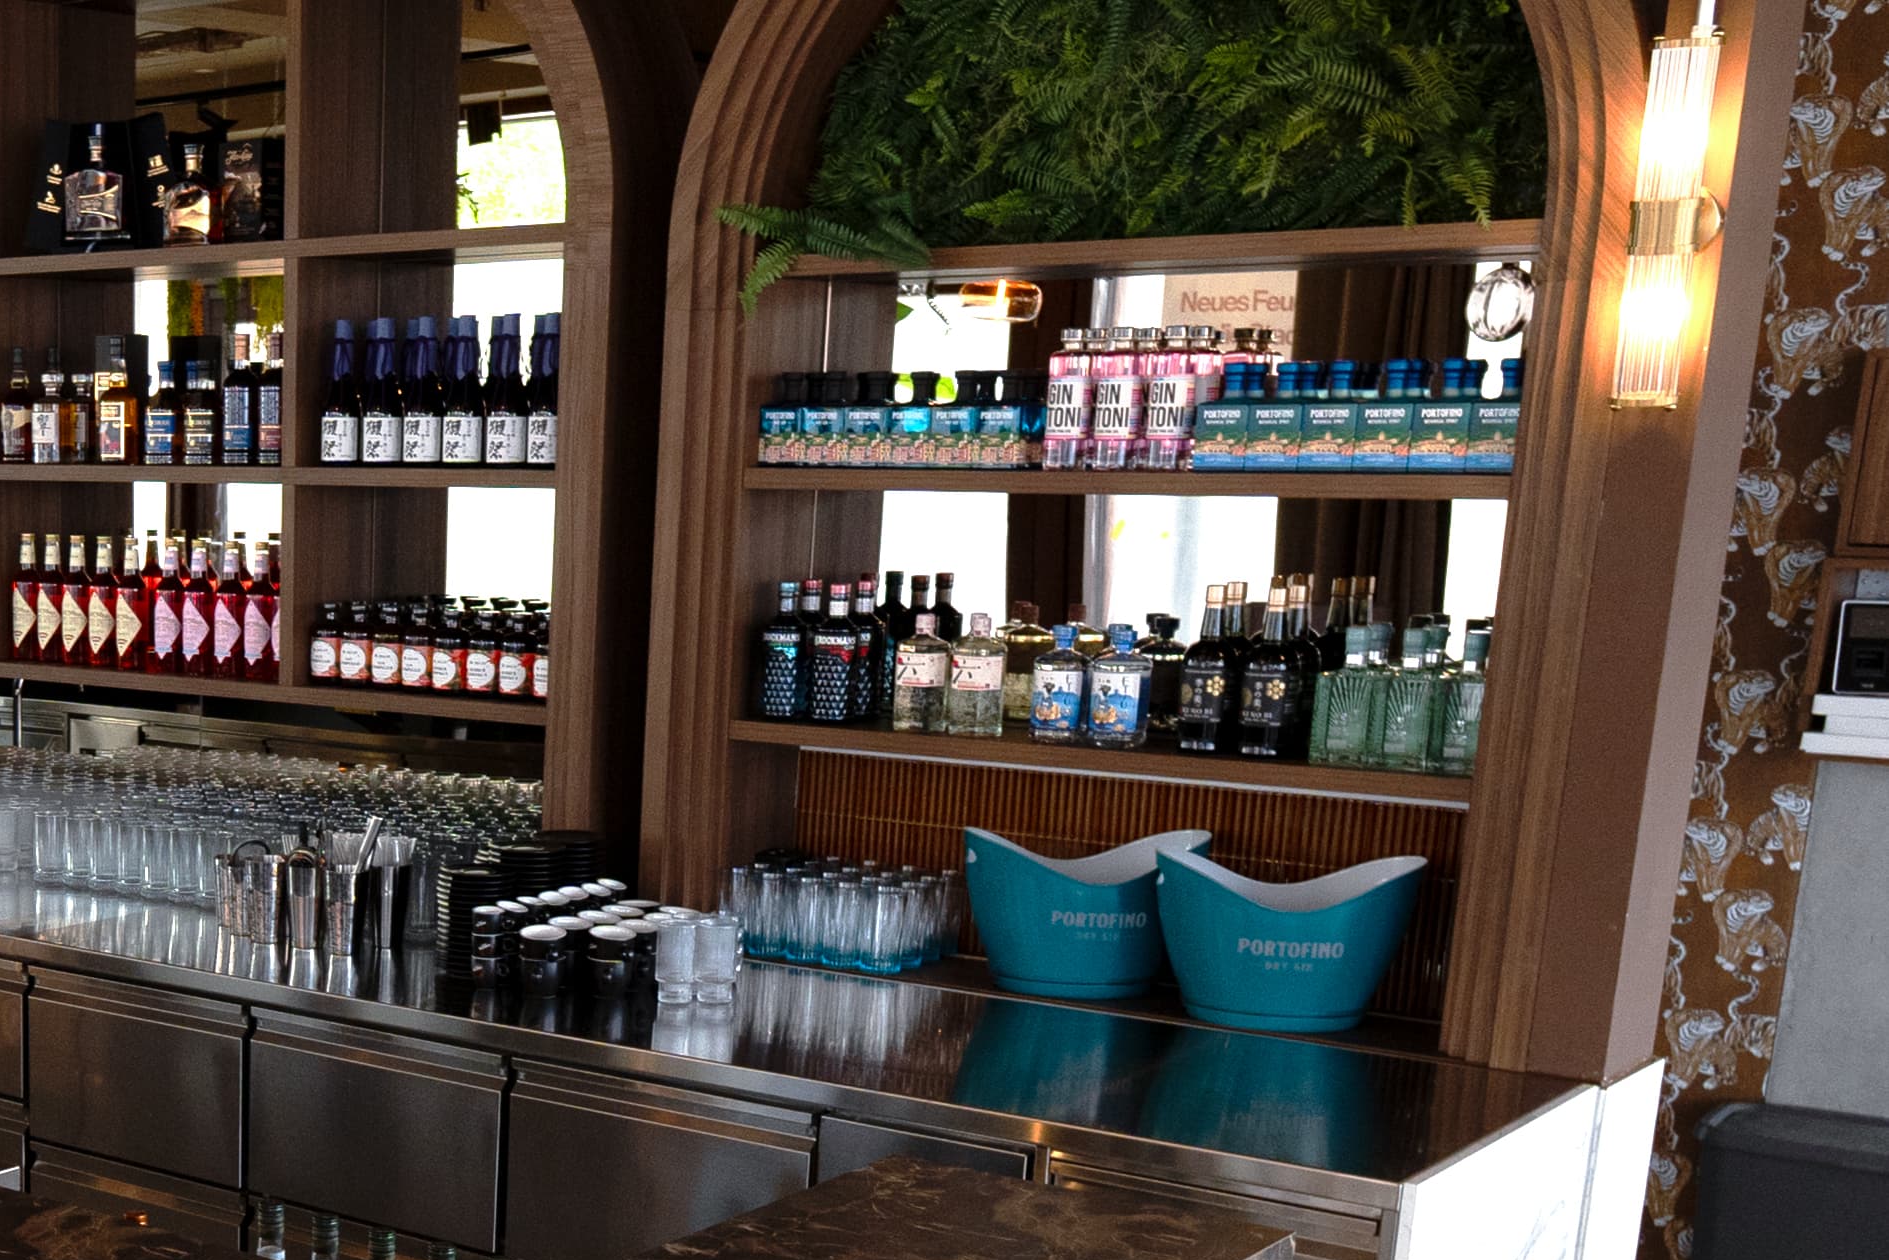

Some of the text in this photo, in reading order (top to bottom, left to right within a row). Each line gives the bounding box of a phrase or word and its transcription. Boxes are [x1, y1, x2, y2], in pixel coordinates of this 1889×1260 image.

[1180, 290, 1250, 313] Neues
[1048, 384, 1073, 404] GIN
[1097, 384, 1122, 404] GIN
[1150, 383, 1176, 404] GIN
[1203, 409, 1241, 419] PORTOFINO
[1256, 409, 1294, 419] PORTOFINO
[1310, 409, 1350, 419] PORTOFINO
[1364, 408, 1406, 418] PORTOFINO
[1421, 408, 1463, 418] PORTOFINO
[1051, 910, 1147, 928] PORTOFINO
[1237, 937, 1345, 958] PORTOFINO
